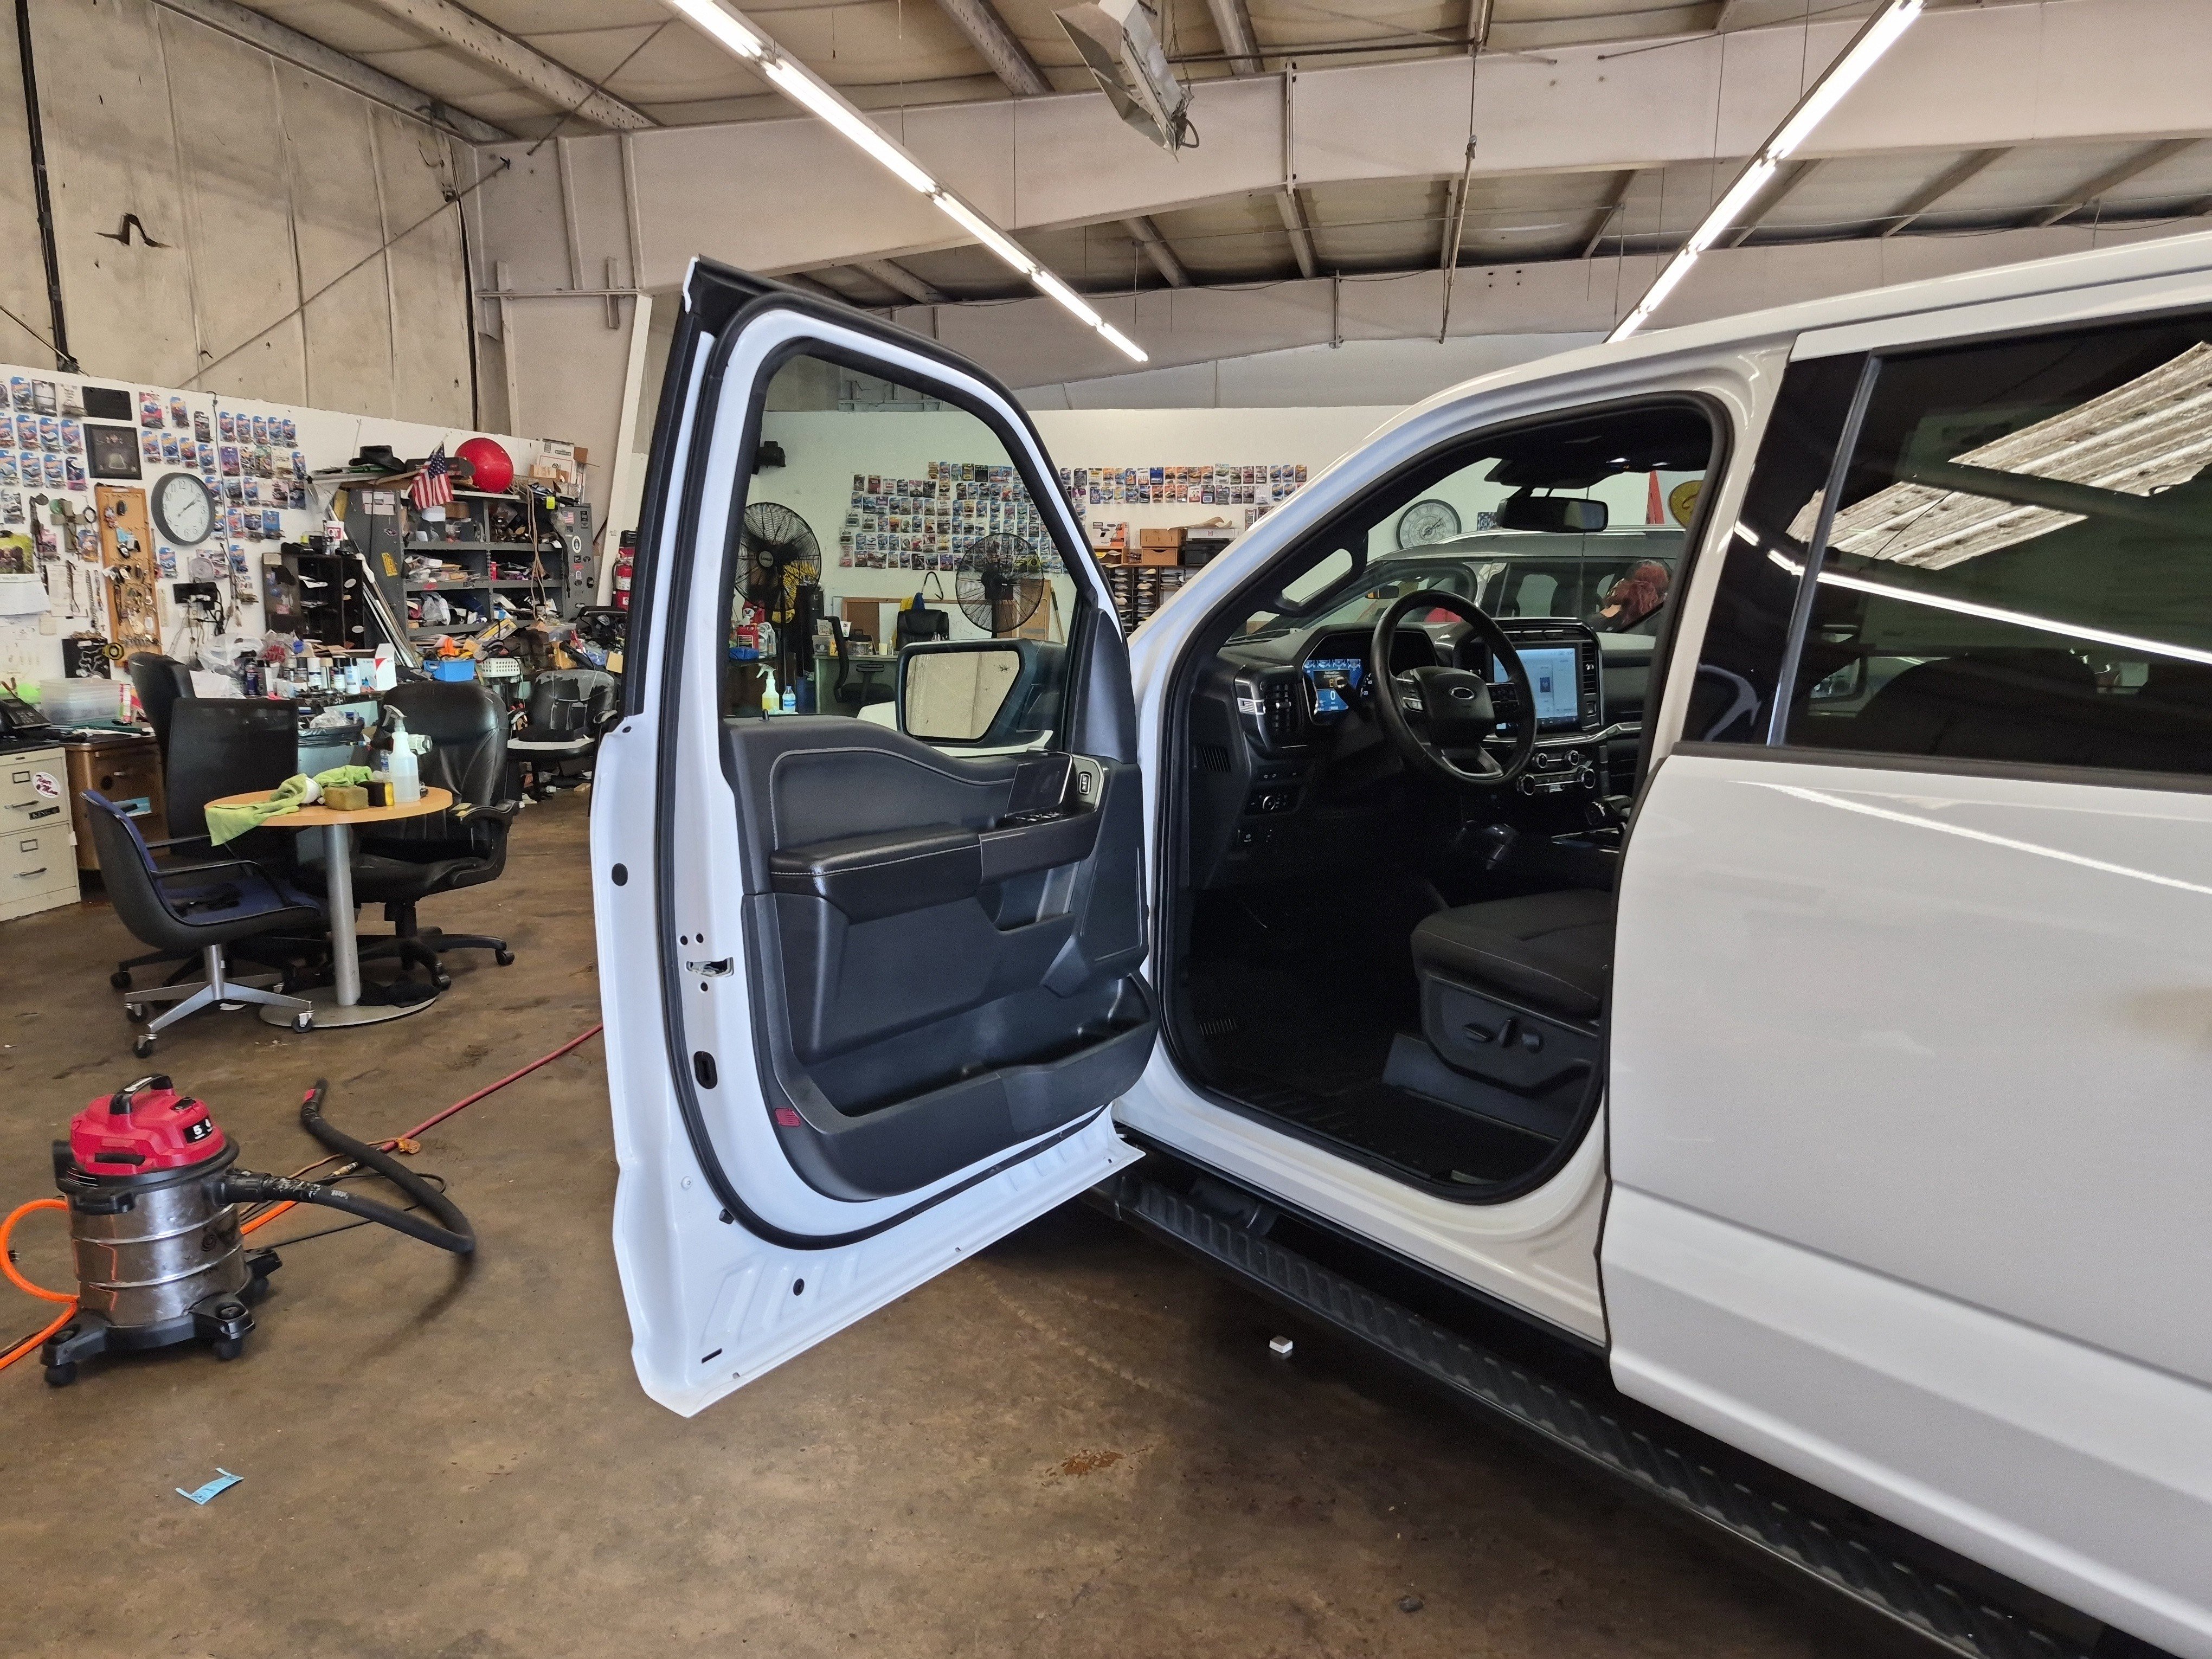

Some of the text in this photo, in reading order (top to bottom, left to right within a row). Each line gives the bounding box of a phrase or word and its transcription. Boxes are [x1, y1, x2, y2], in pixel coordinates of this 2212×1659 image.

[171, 483, 176, 493] 11
[178, 480, 185, 490] 12
[327, 528, 340, 537] QT
[1330, 690, 1336, 700] 0
[192, 1124, 203, 1135] 5
